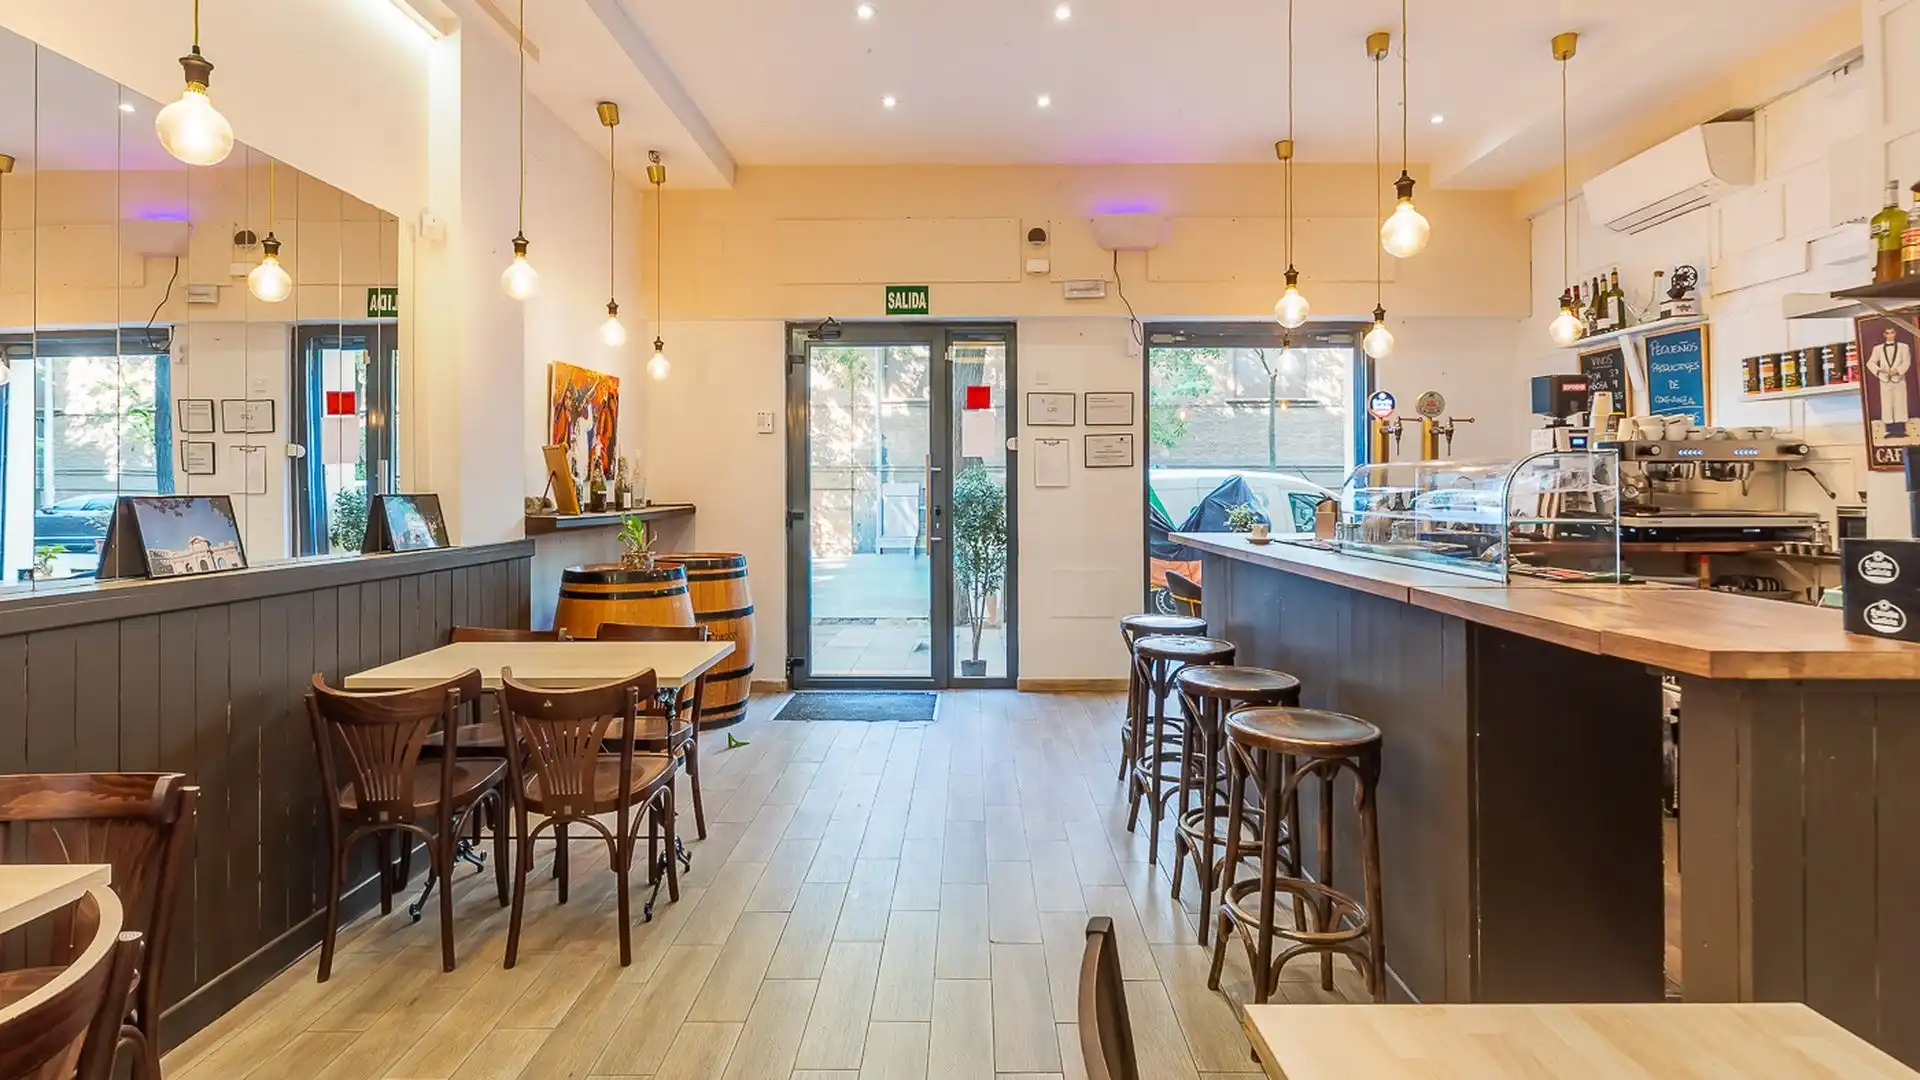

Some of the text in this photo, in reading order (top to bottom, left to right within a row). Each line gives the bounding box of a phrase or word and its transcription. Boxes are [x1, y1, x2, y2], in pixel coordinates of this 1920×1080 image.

[888, 291, 927, 309] SALIDA
[1650, 340, 1698, 356] PEQUEÑOS
[1668, 380, 1680, 389] DE
[1876, 448, 1903, 463] CAF
